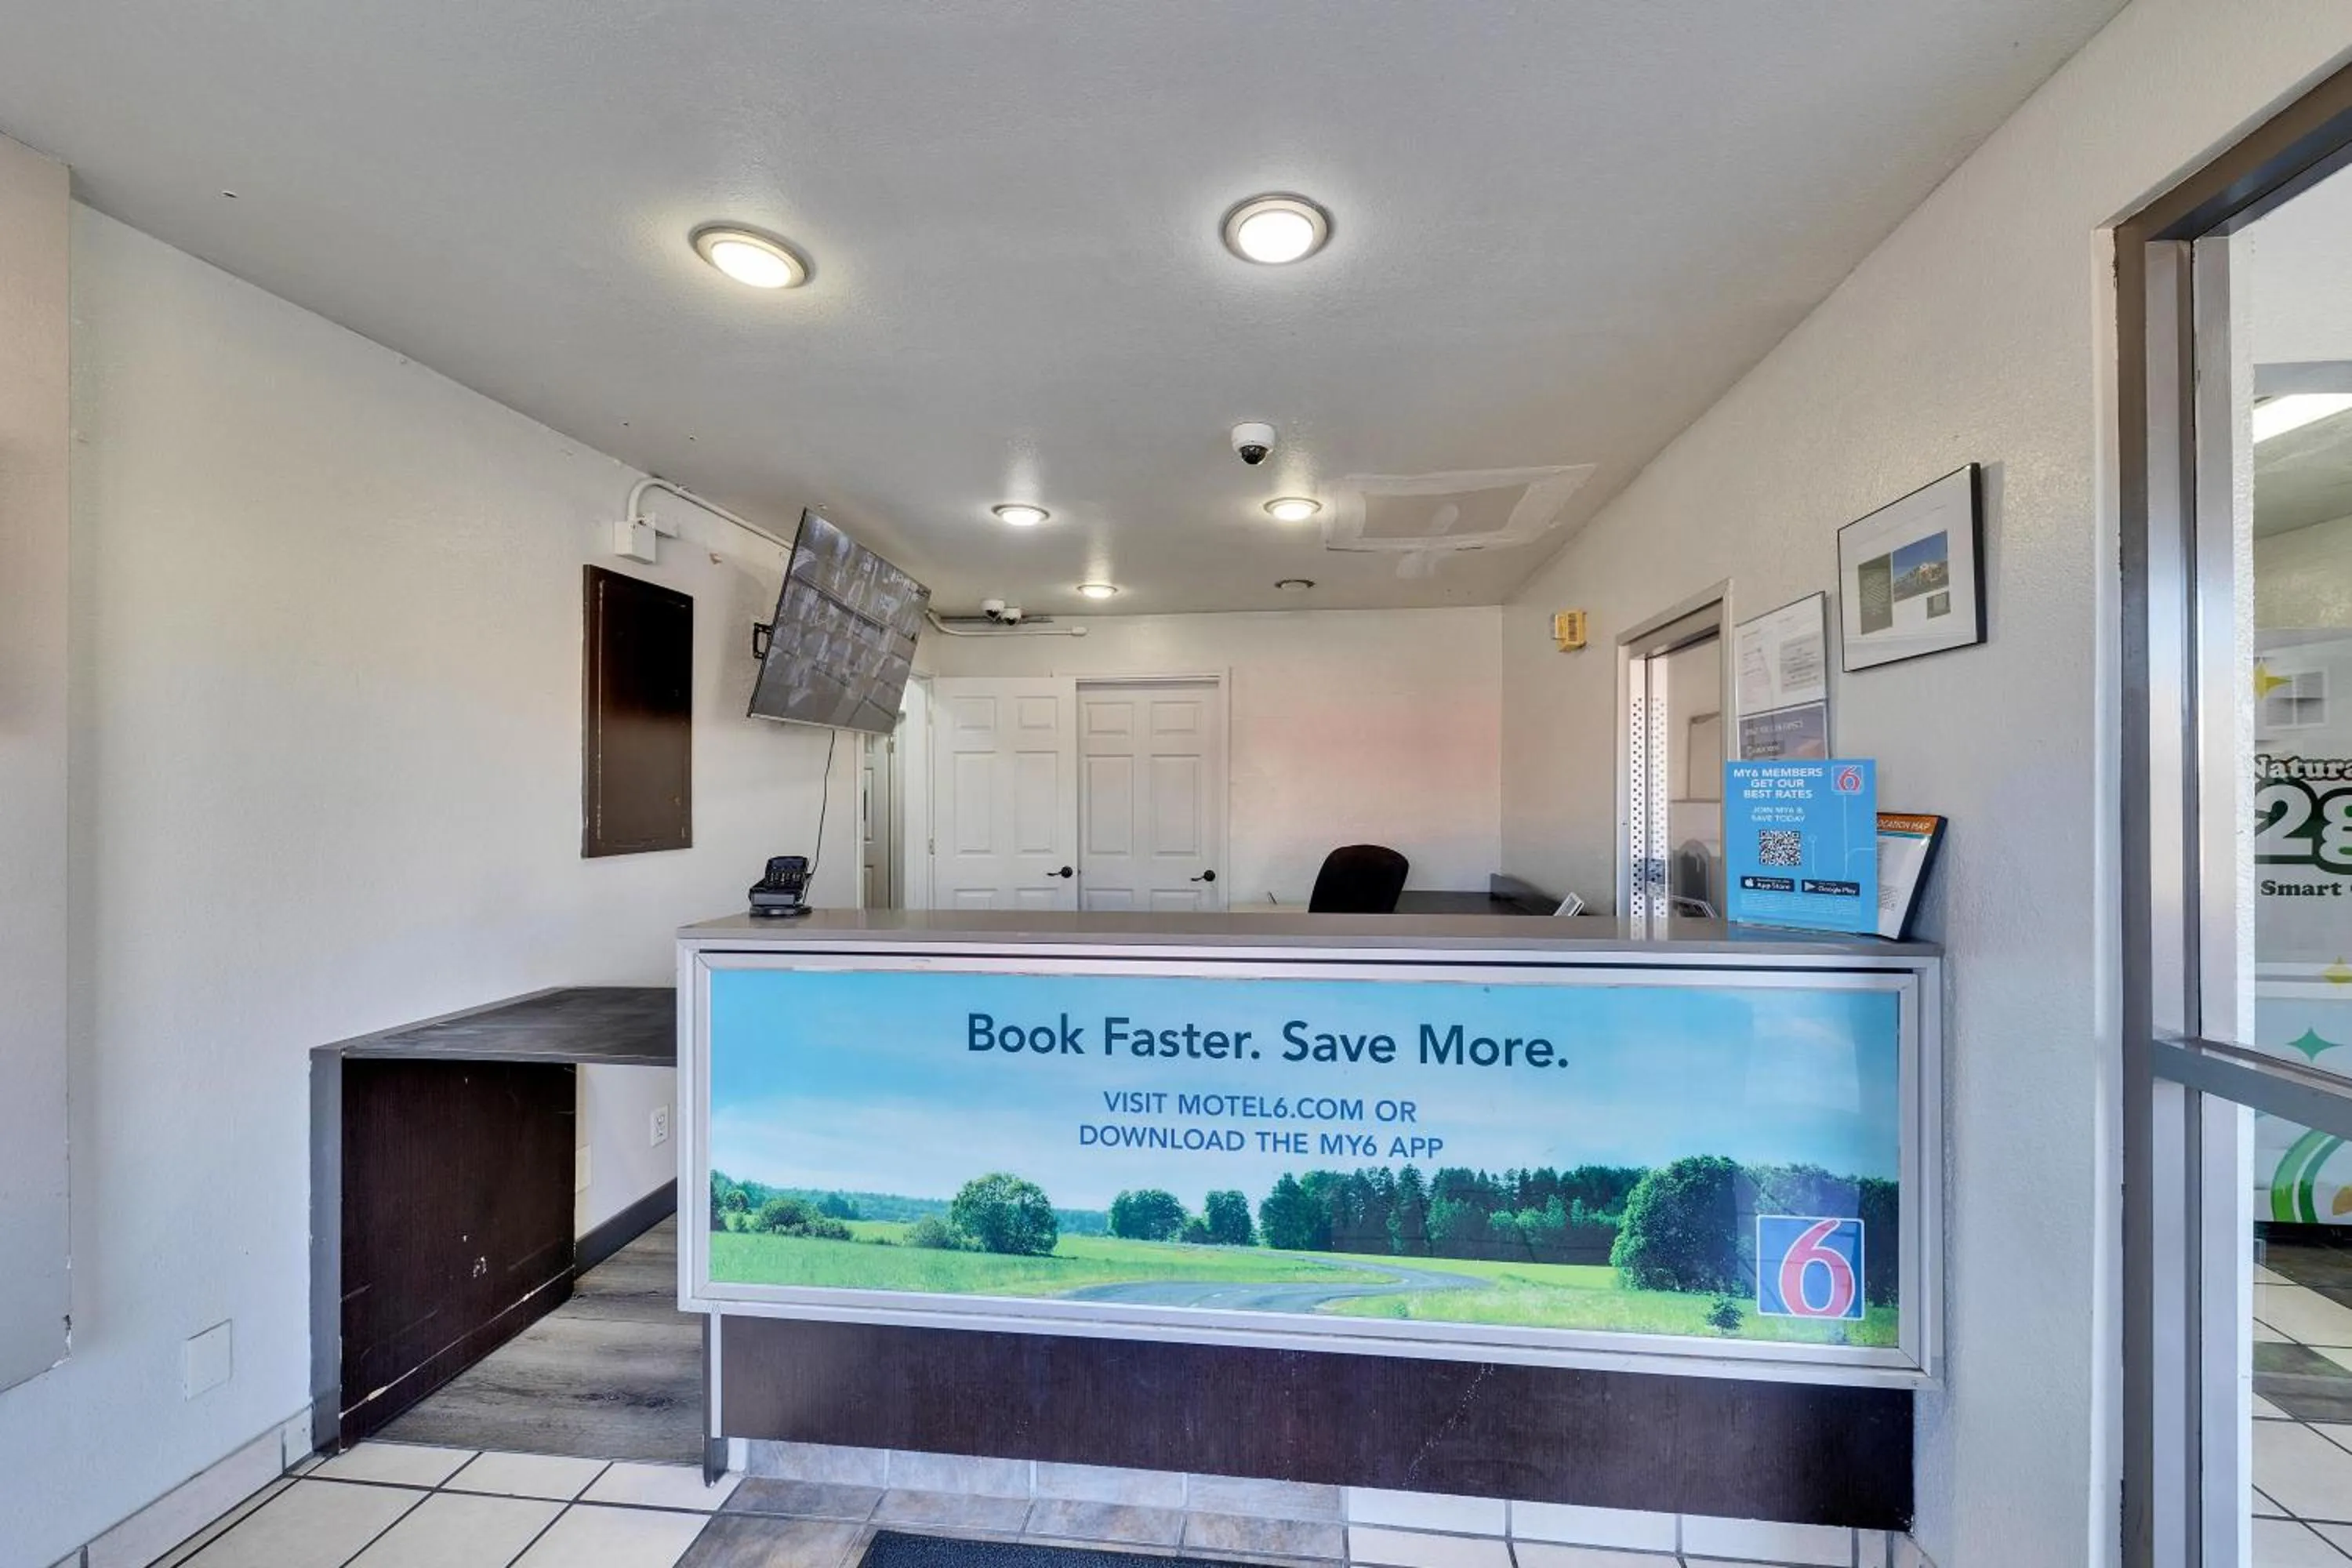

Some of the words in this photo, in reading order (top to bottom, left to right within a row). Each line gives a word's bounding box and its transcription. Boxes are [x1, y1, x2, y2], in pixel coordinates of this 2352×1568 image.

[1733, 768, 1759, 778] MY6
[1762, 768, 1823, 778] MEMBERS
[1751, 779, 1773, 788] GET
[1777, 779, 1805, 788] OUR
[1743, 789, 1773, 799] BEST
[1775, 789, 1813, 799] RATES
[1774, 815, 1806, 823] TODAY
[1878, 819, 1911, 829] OCATION
[1911, 821, 1931, 830] MAP
[2261, 880, 2342, 896] Smart
[968, 1012, 1085, 1054] Book
[1105, 1016, 1261, 1060] Faster.
[1282, 1020, 1396, 1064] Save
[1420, 1023, 1569, 1069] More.
[1103, 1091, 1167, 1114] VISIT
[1178, 1094, 1363, 1121] MOTEL6.COM
[1374, 1099, 1417, 1123] OR
[1080, 1124, 1246, 1152] DOWNLOAD
[1254, 1131, 1308, 1155] THE
[1319, 1133, 1377, 1157] MY6
[1388, 1136, 1443, 1160] APP
[1779, 1218, 1855, 1318] 6
